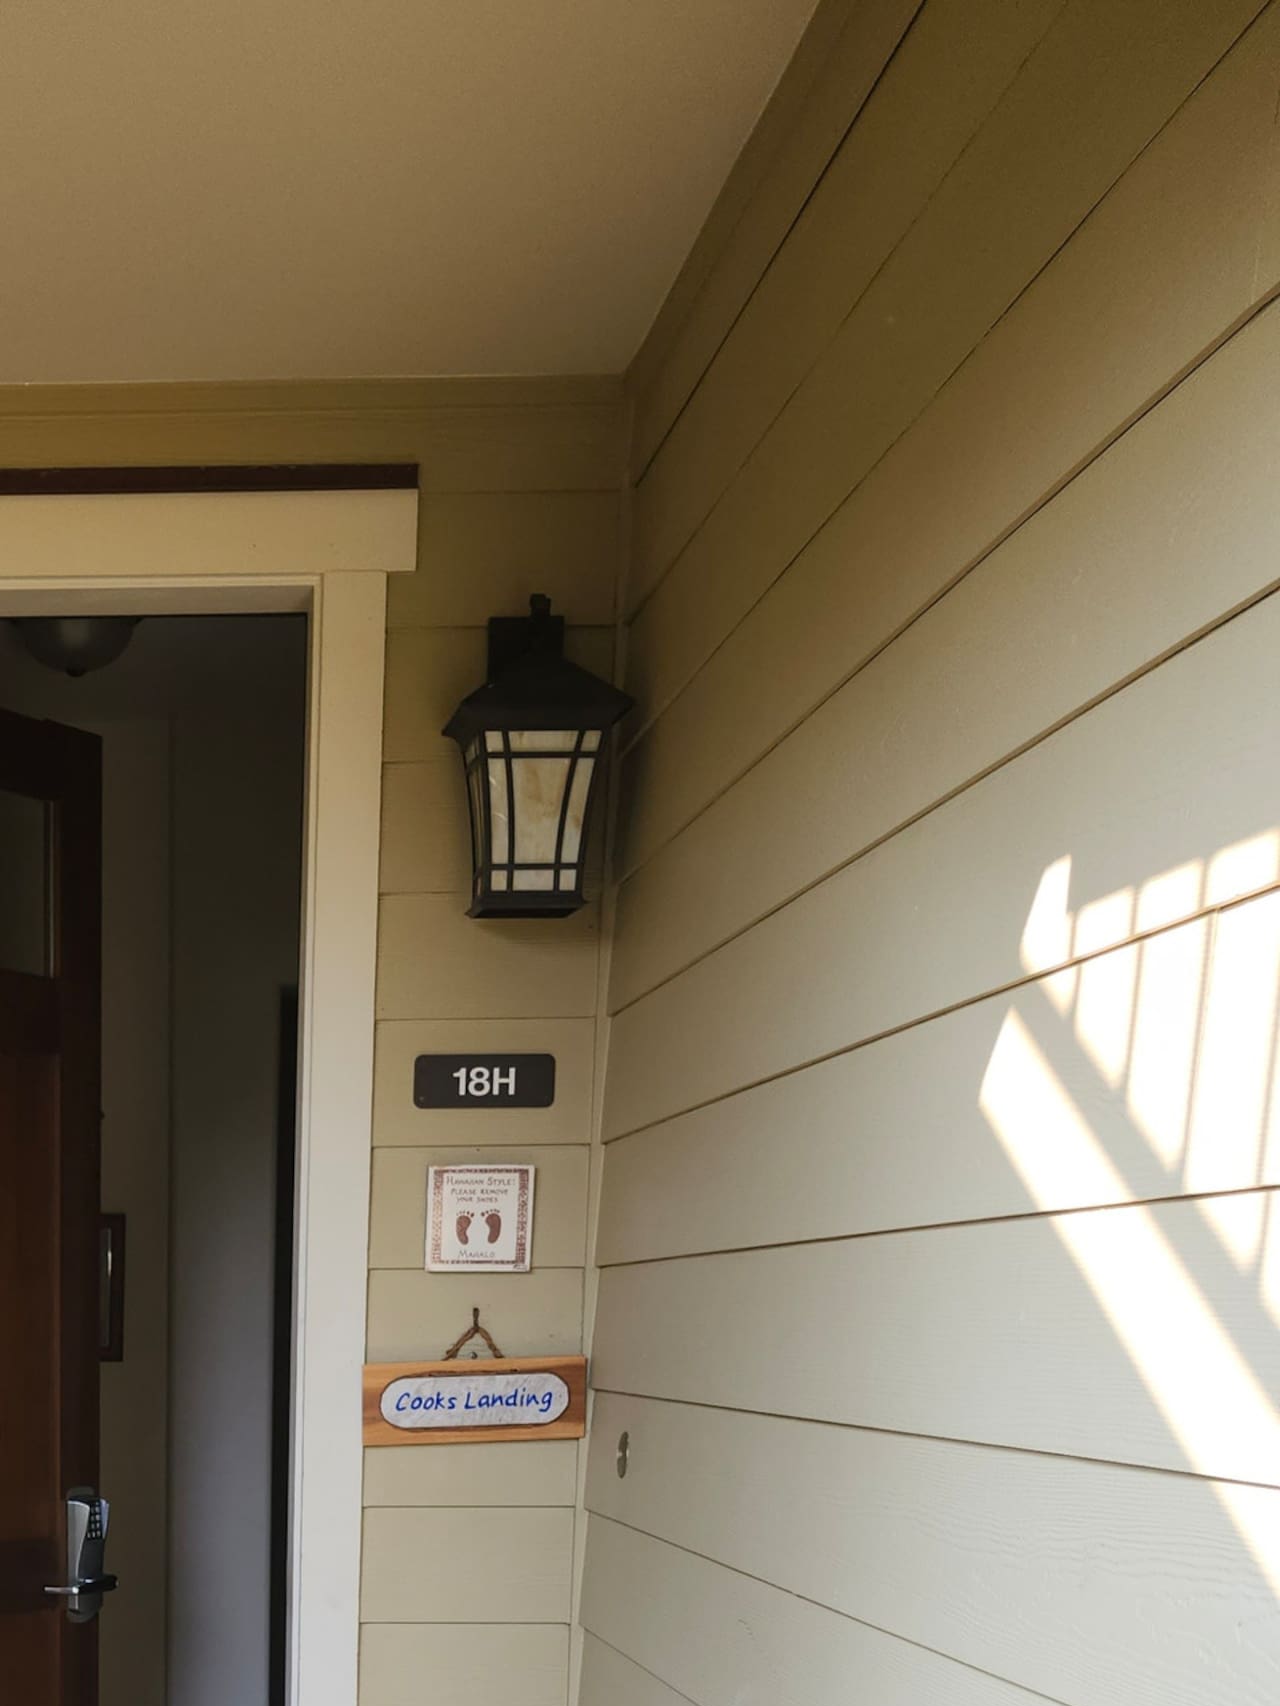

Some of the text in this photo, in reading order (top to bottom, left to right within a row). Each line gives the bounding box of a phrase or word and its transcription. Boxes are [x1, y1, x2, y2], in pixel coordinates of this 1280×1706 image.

[452, 1067, 516, 1096] 18H
[395, 1387, 553, 1412] Cooks Landing
